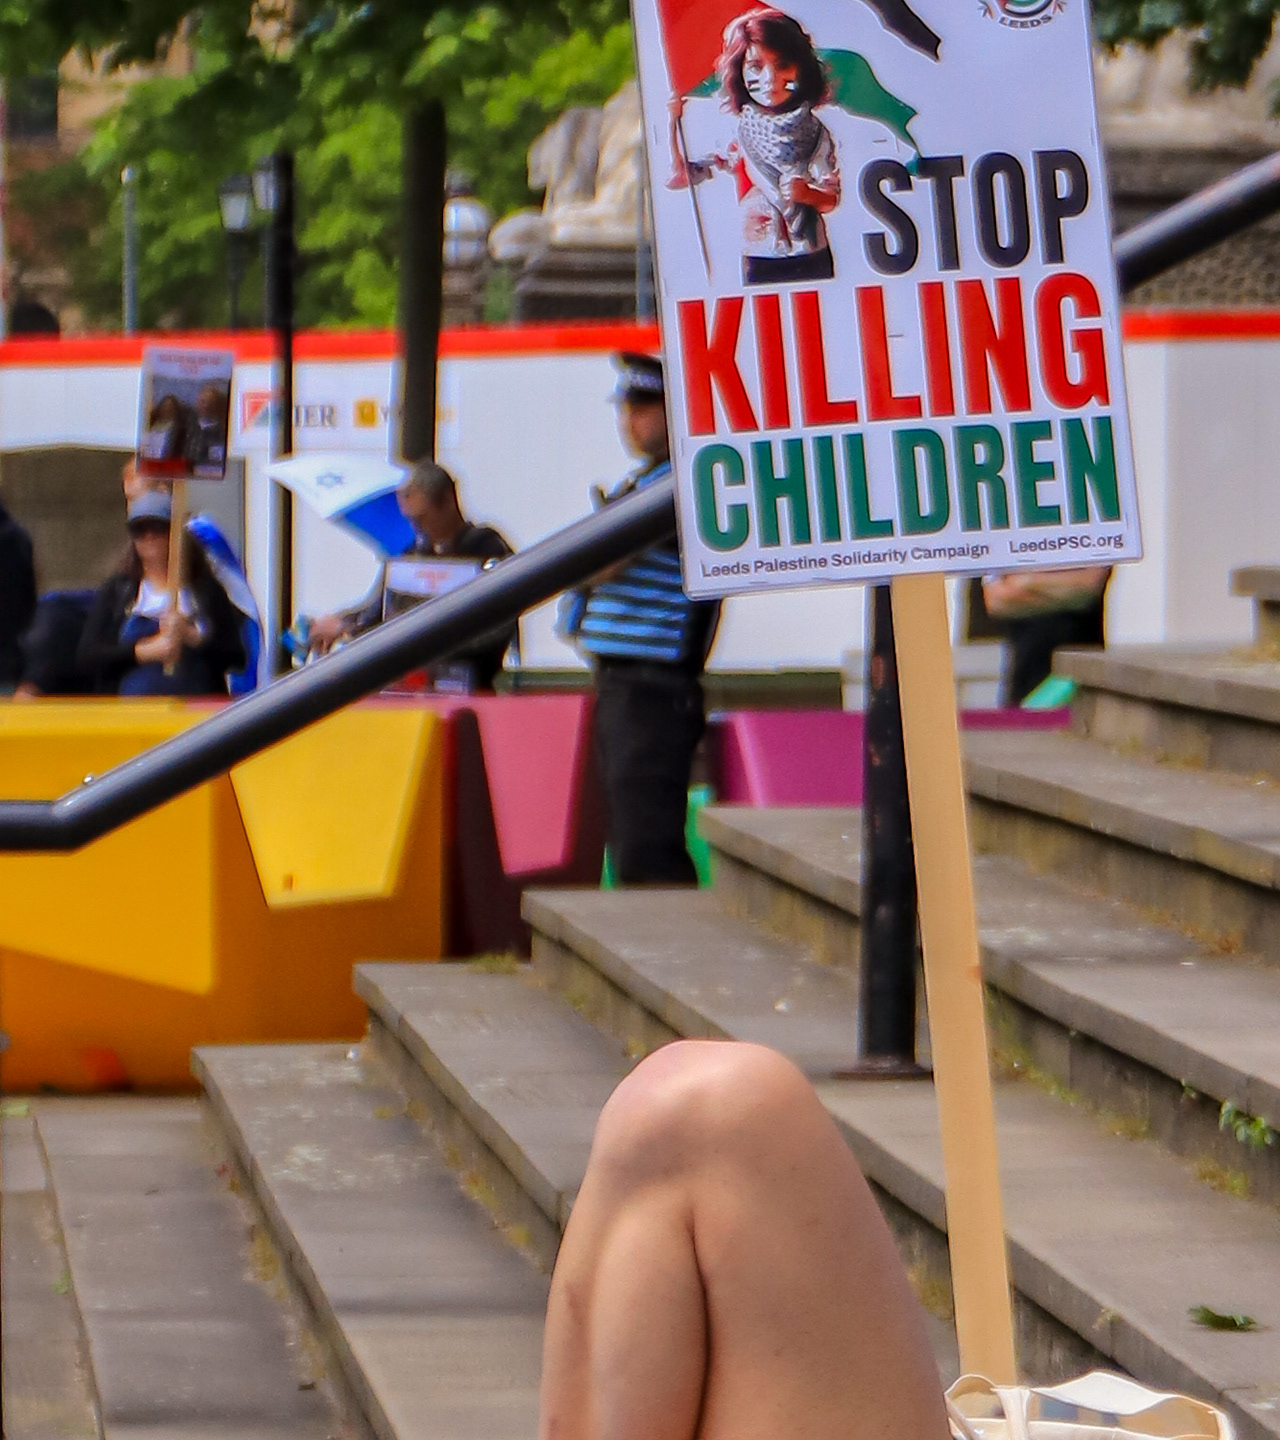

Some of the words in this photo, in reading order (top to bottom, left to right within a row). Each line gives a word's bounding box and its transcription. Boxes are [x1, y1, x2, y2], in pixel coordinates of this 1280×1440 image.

[998, 14, 1053, 29] LEEDS
[858, 148, 1090, 277] STOP
[675, 271, 1111, 438] KILLING
[692, 415, 1122, 552] CHILDREN
[701, 561, 750, 578] Leeds
[754, 555, 828, 574] Palestine
[831, 547, 908, 567] Solidarity
[910, 543, 990, 561] Campaign
[1009, 533, 1124, 554] LeedsPSC.org
